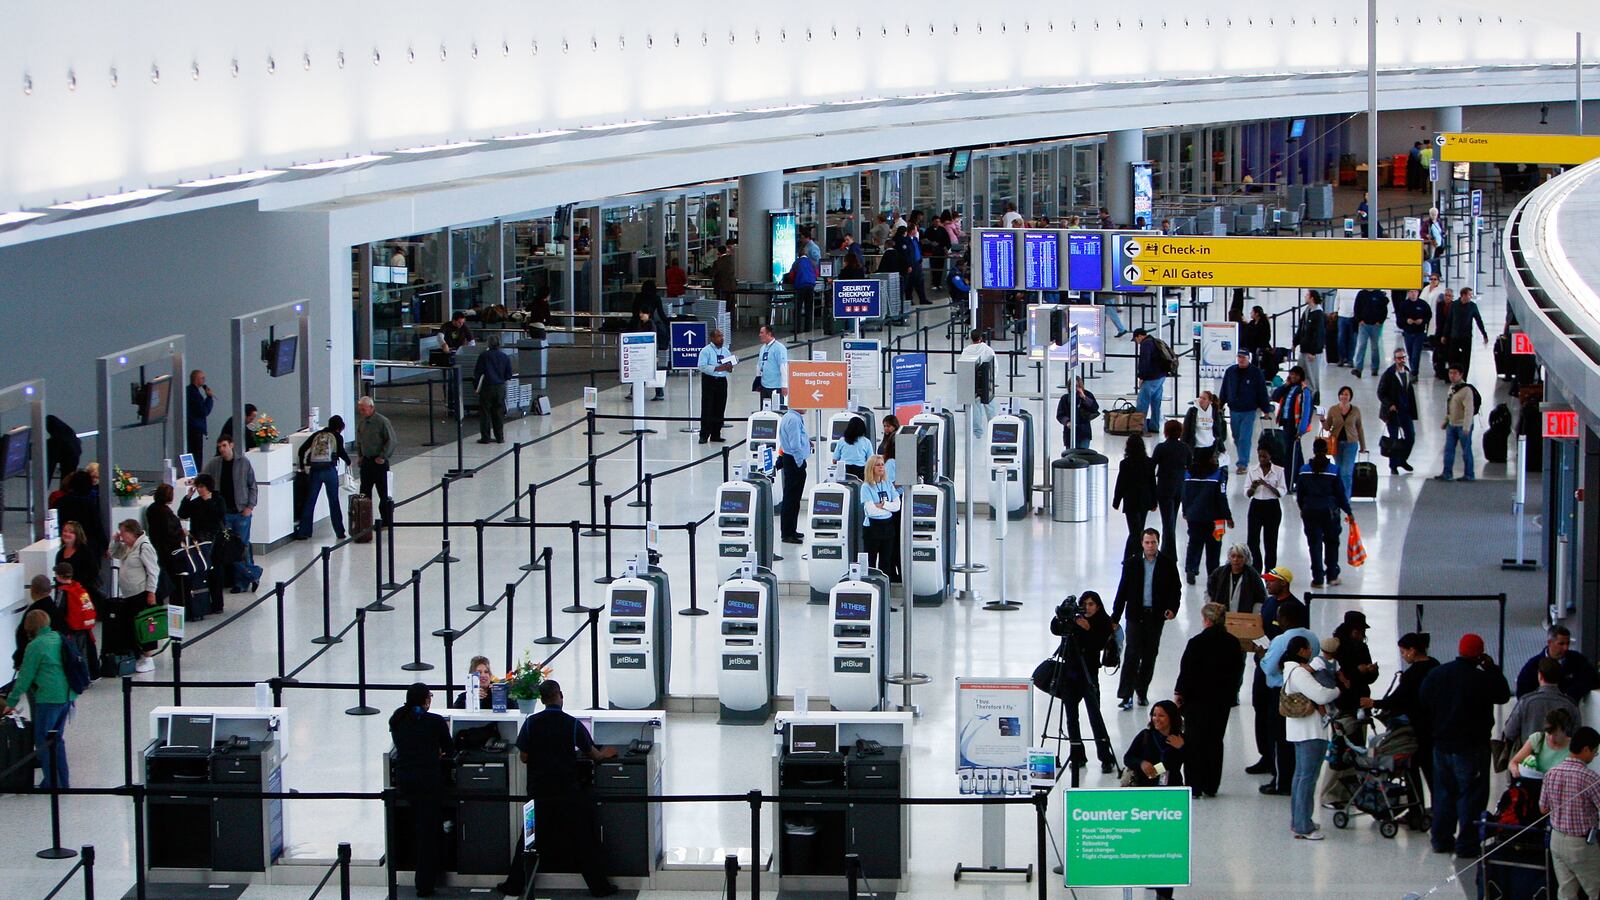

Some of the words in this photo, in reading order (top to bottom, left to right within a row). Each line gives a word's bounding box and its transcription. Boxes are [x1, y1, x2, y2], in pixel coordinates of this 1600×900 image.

[1162, 244, 1210, 254] Check-in
[1162, 268, 1178, 278] All
[1181, 269, 1214, 278] Gates
[1547, 413, 1576, 434] EXIT
[616, 599, 642, 608] GREETINGS
[727, 600, 755, 610] GREETINGS
[848, 602, 866, 612] THERE
[616, 656, 639, 664] jetBlue
[728, 657, 751, 666] jetBlue
[840, 660, 864, 668] jetBlue
[1072, 808, 1128, 821] Counter
[1130, 808, 1182, 820] Service
